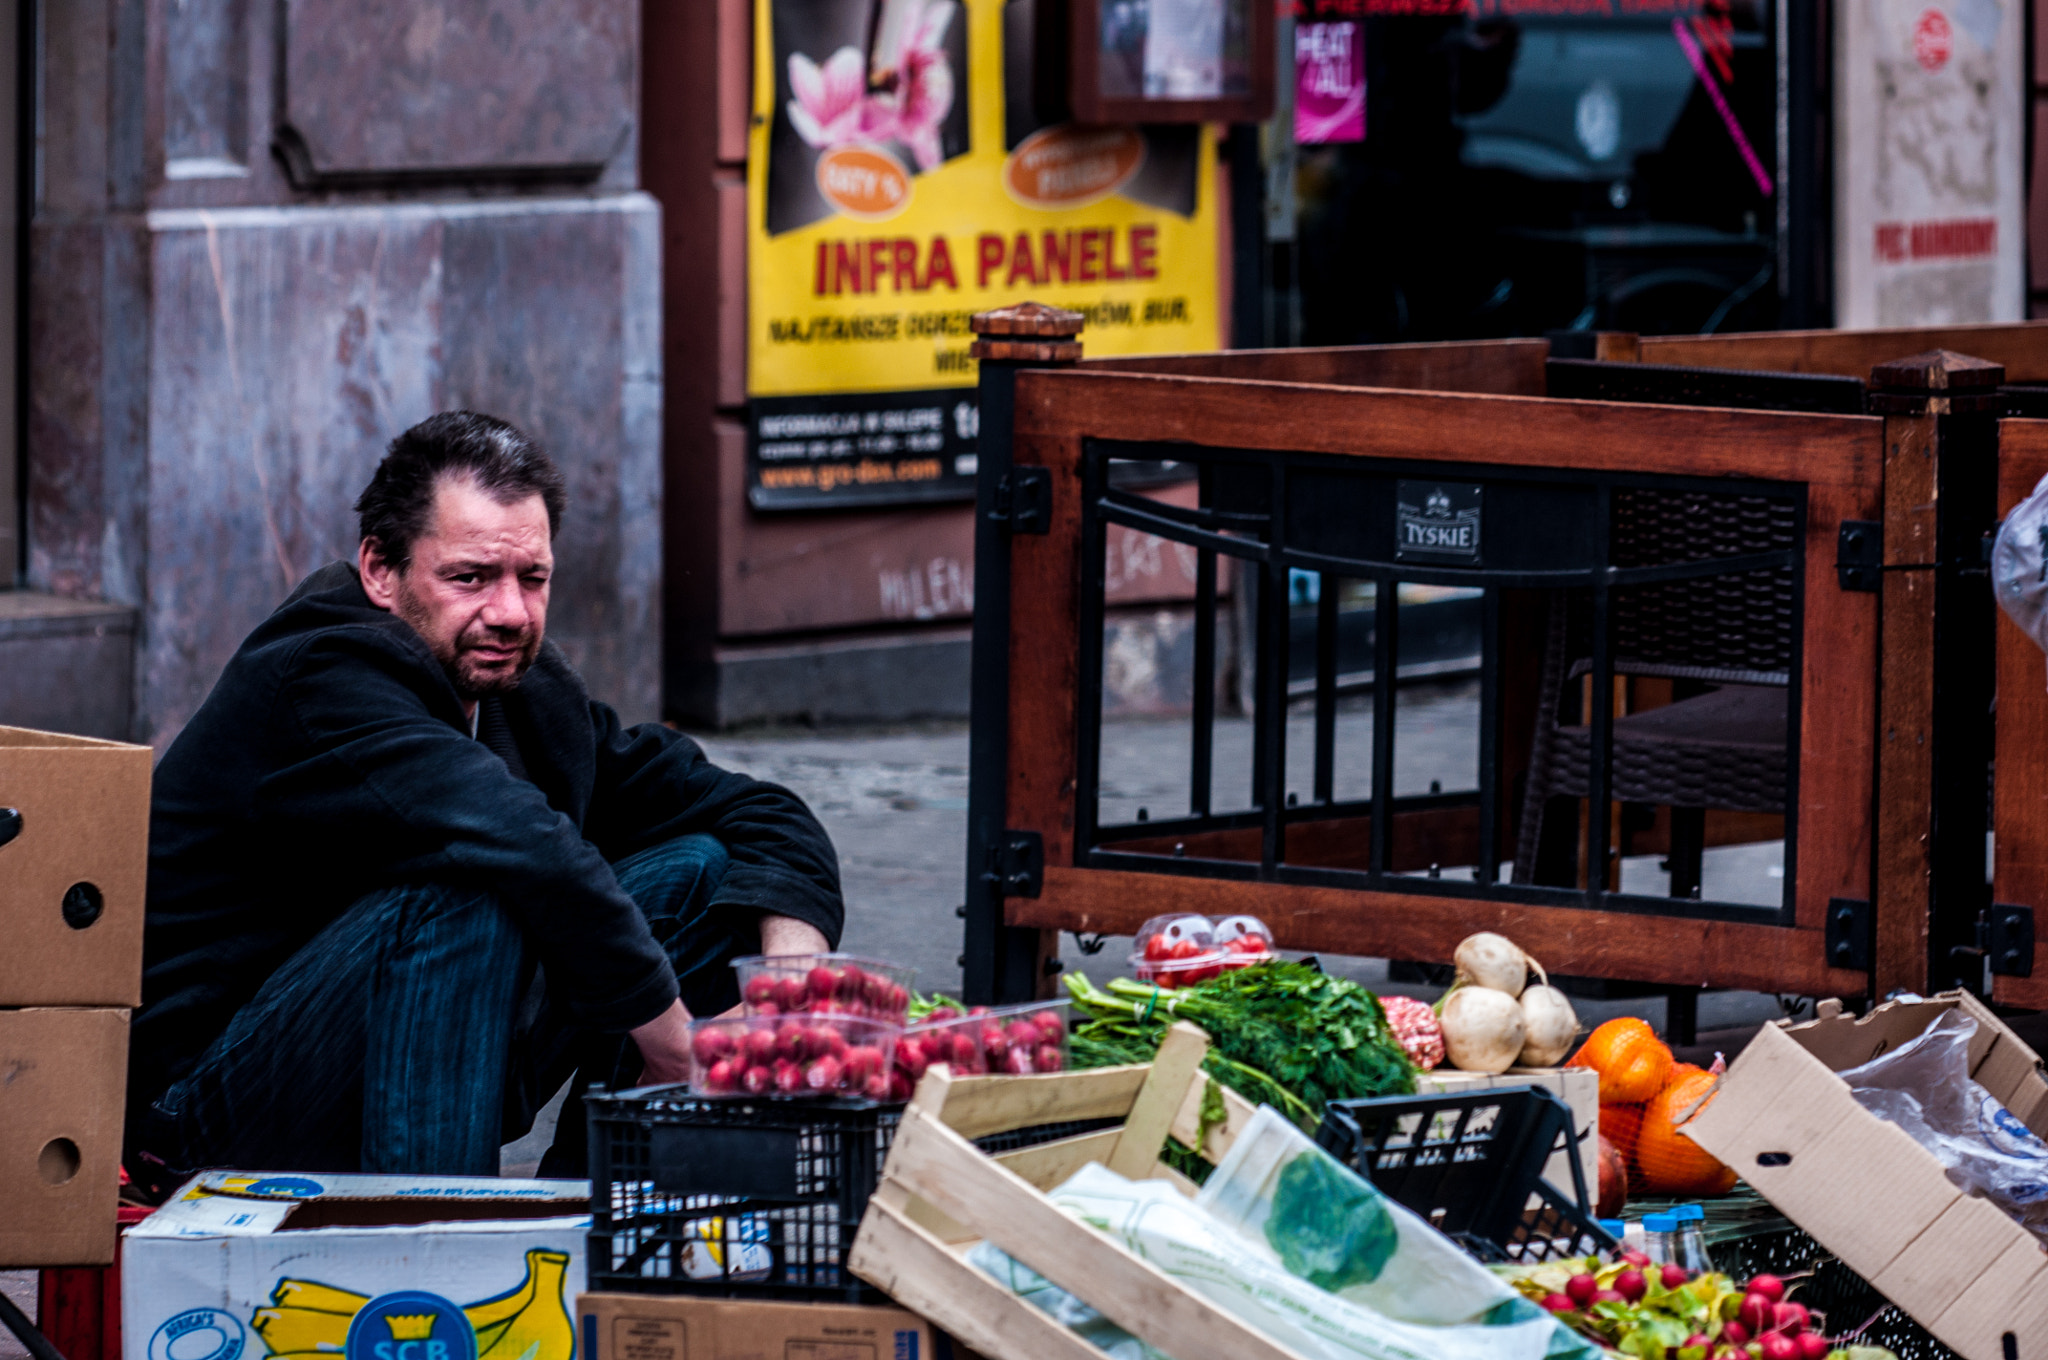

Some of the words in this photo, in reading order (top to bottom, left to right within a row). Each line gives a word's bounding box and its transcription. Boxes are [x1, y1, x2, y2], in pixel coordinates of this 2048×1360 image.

[814, 237, 958, 296] INFRA
[976, 225, 1158, 290] PANELE
[1405, 521, 1471, 547] TYSKIE
[373, 1339, 450, 1360] SCB
